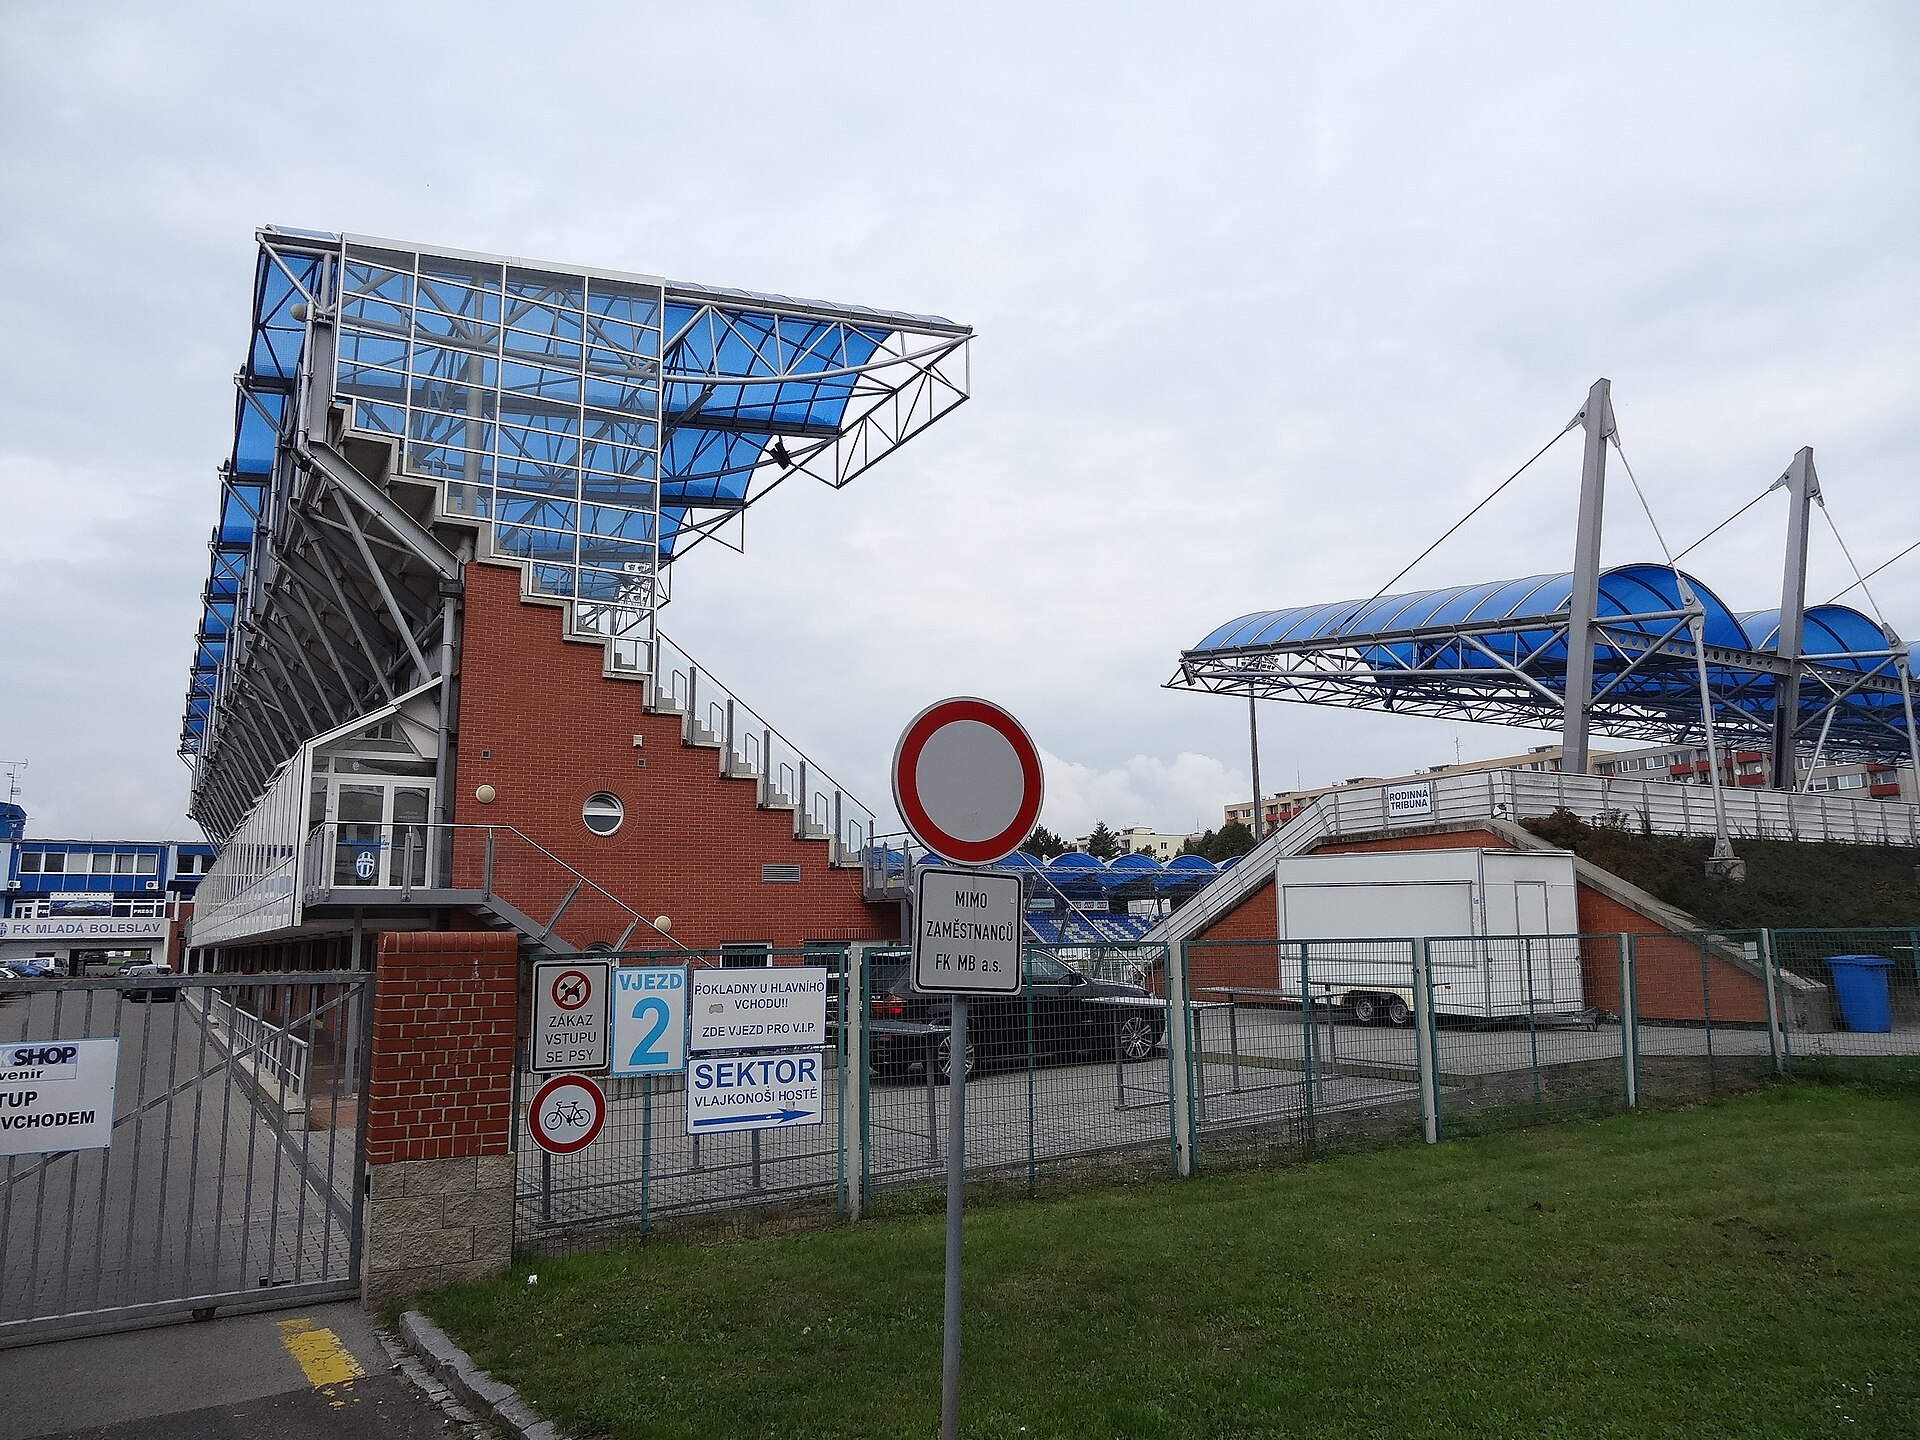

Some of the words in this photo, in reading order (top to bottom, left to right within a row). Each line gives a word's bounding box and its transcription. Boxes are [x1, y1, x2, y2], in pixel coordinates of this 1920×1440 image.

[1389, 786, 1429, 801] RODINNÁ
[1390, 799, 1428, 810] TRIBUNA
[955, 890, 988, 909] MIMO
[12, 924, 31, 934] FK
[35, 922, 85, 934] MLADÁ
[89, 923, 161, 934] BOLESLAV
[926, 917, 1014, 942] ZAMĚSTNANCŮ
[935, 953, 951, 971] FK
[957, 954, 976, 971] MB
[981, 959, 1002, 973] a.s.
[620, 973, 683, 991] VJEZD
[694, 983, 757, 996] POKLADNY
[760, 983, 767, 994] U
[770, 979, 825, 993] HLAVNÍHO
[734, 997, 788, 1010] VCHODU!!
[548, 1012, 594, 1028] ZÁKAZ
[545, 1031, 597, 1045] VSTUPU
[628, 996, 671, 1067] 2
[702, 1026, 726, 1038] ZDE
[728, 1024, 764, 1037] VJEZD
[766, 1023, 790, 1034] PRO
[792, 1022, 816, 1033] V.I.P.
[13, 1046, 77, 1067] SHOP
[546, 1051, 563, 1063] SE
[568, 1048, 595, 1062] PSY
[694, 1057, 818, 1090] SEKTOR
[694, 1089, 775, 1108] VLAJKONOŠI
[778, 1086, 818, 1101] HOSTÉ
[1, 1110, 96, 1130] VCHODEM
